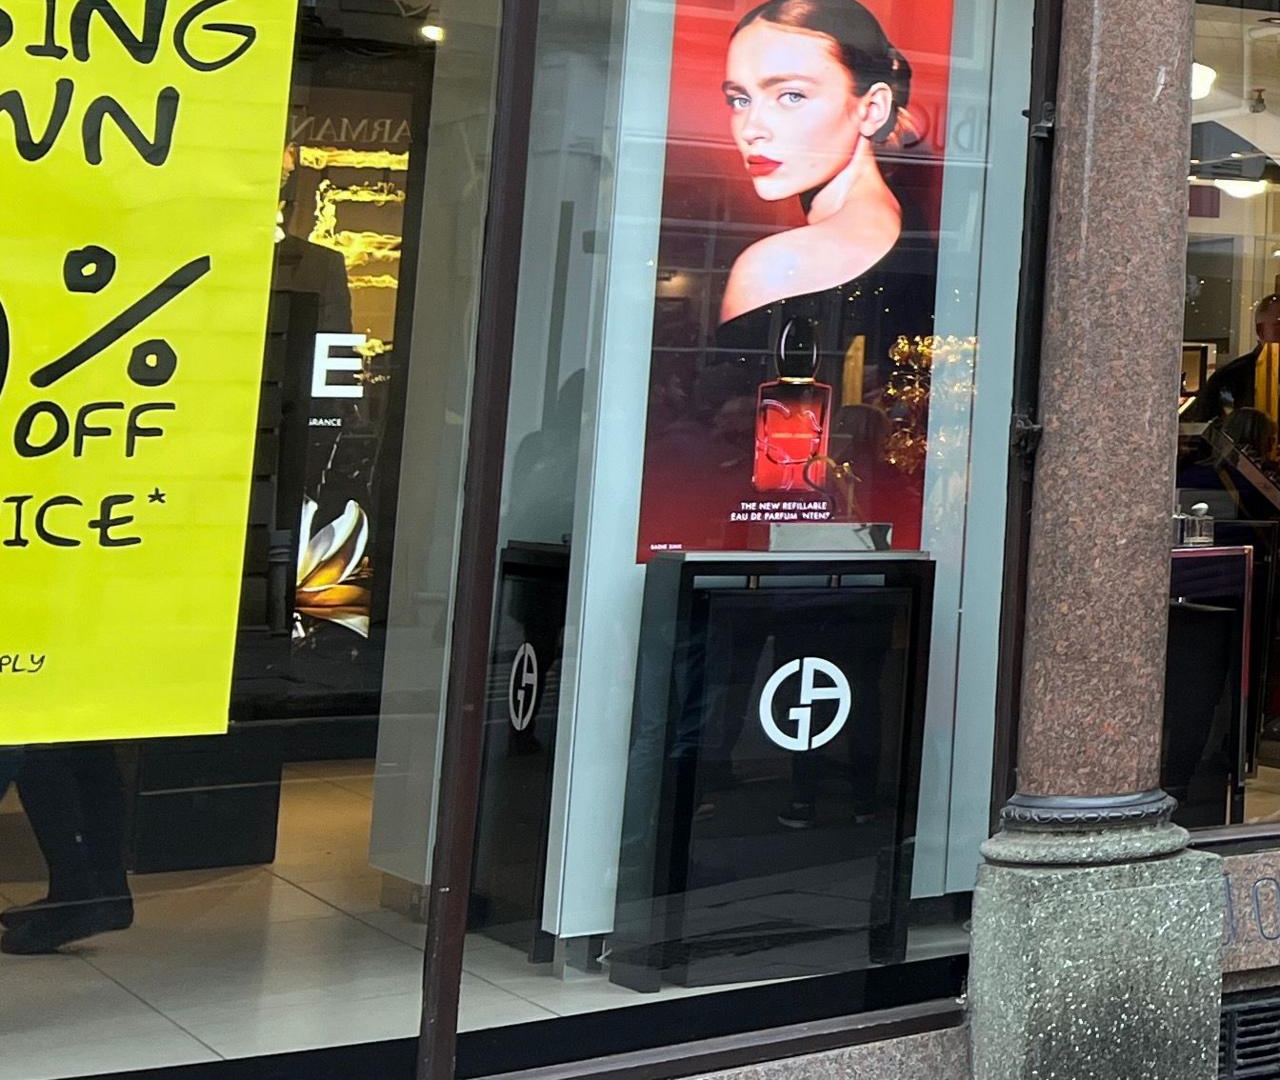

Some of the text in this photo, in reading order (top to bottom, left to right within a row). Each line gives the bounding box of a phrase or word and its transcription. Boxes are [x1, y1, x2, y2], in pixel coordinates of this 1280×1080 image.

[14, 400, 176, 458] OFF
[741, 501, 828, 510] THE NEW REFILLABLE
[730, 513, 748, 521] EAU
[764, 512, 798, 520] PARFUM
